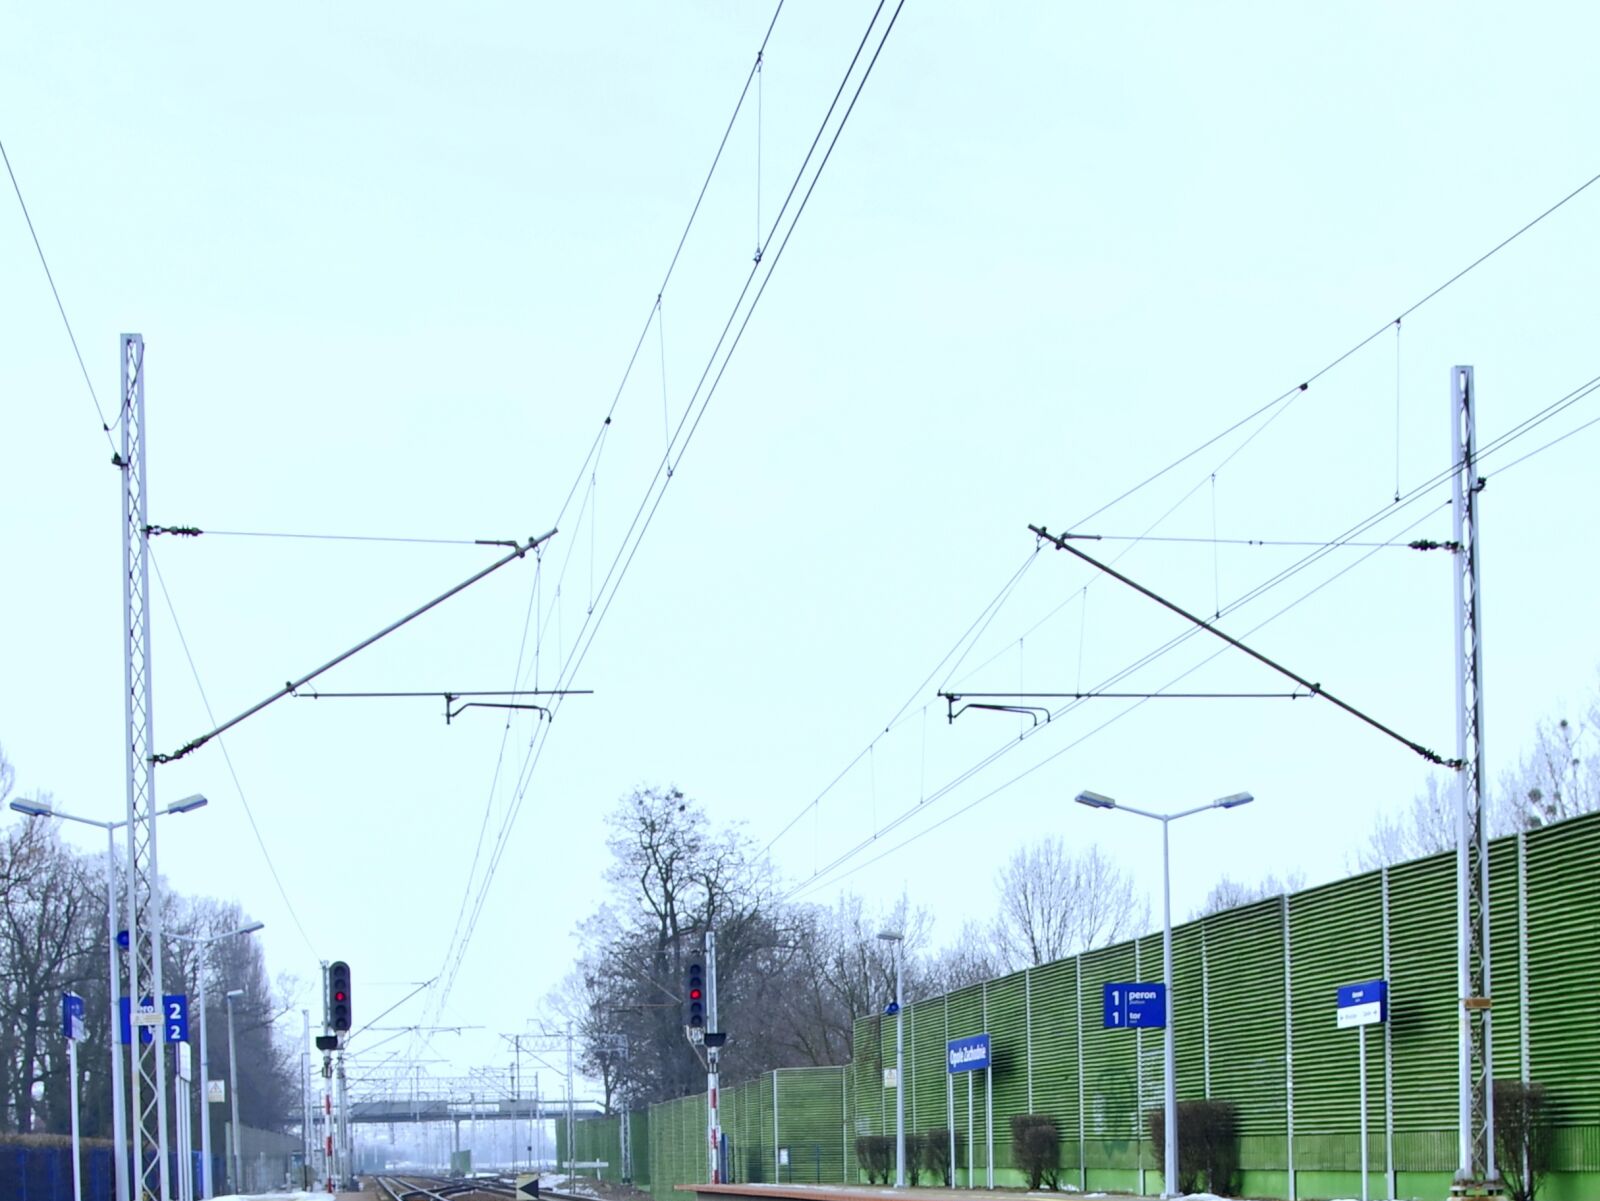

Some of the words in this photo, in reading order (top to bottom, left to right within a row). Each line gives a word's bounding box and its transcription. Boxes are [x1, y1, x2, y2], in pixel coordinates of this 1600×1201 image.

[1112, 990, 1119, 1006] 1
[1129, 991, 1156, 1001] peron
[169, 1003, 181, 1019] 2
[1112, 1011, 1119, 1024] 1
[170, 1025, 181, 1039] 2
